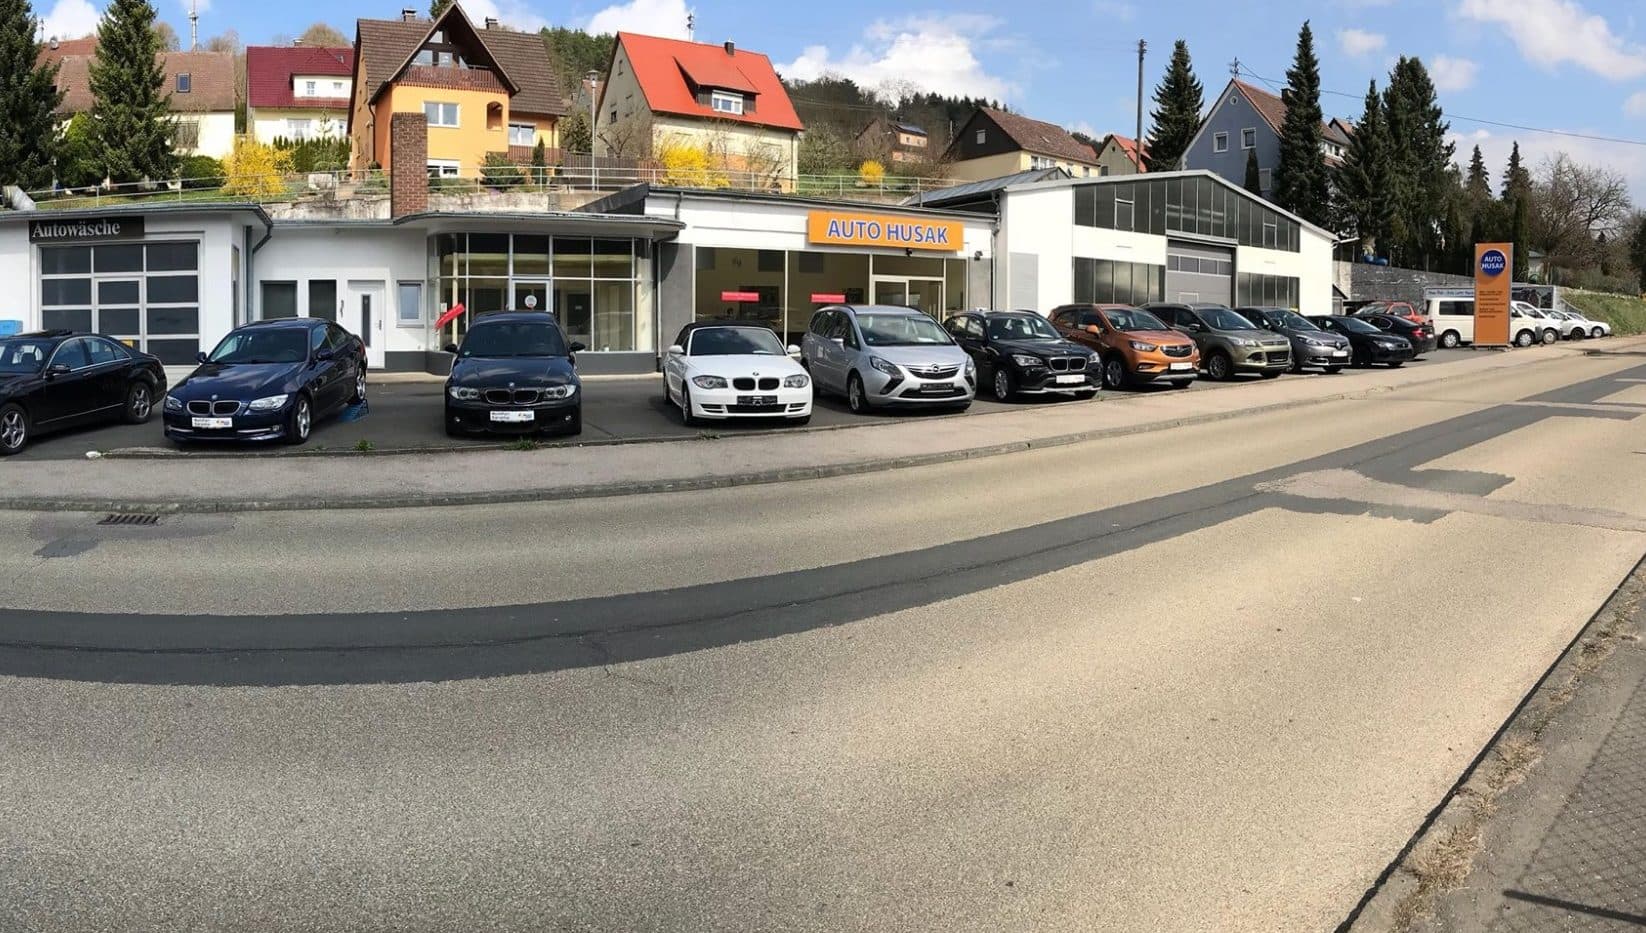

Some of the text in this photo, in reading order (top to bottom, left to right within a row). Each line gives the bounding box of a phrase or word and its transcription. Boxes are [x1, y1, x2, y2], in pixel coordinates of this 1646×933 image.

[32, 219, 120, 238] Autowäsche
[828, 219, 948, 243] AUTO HUSAK
